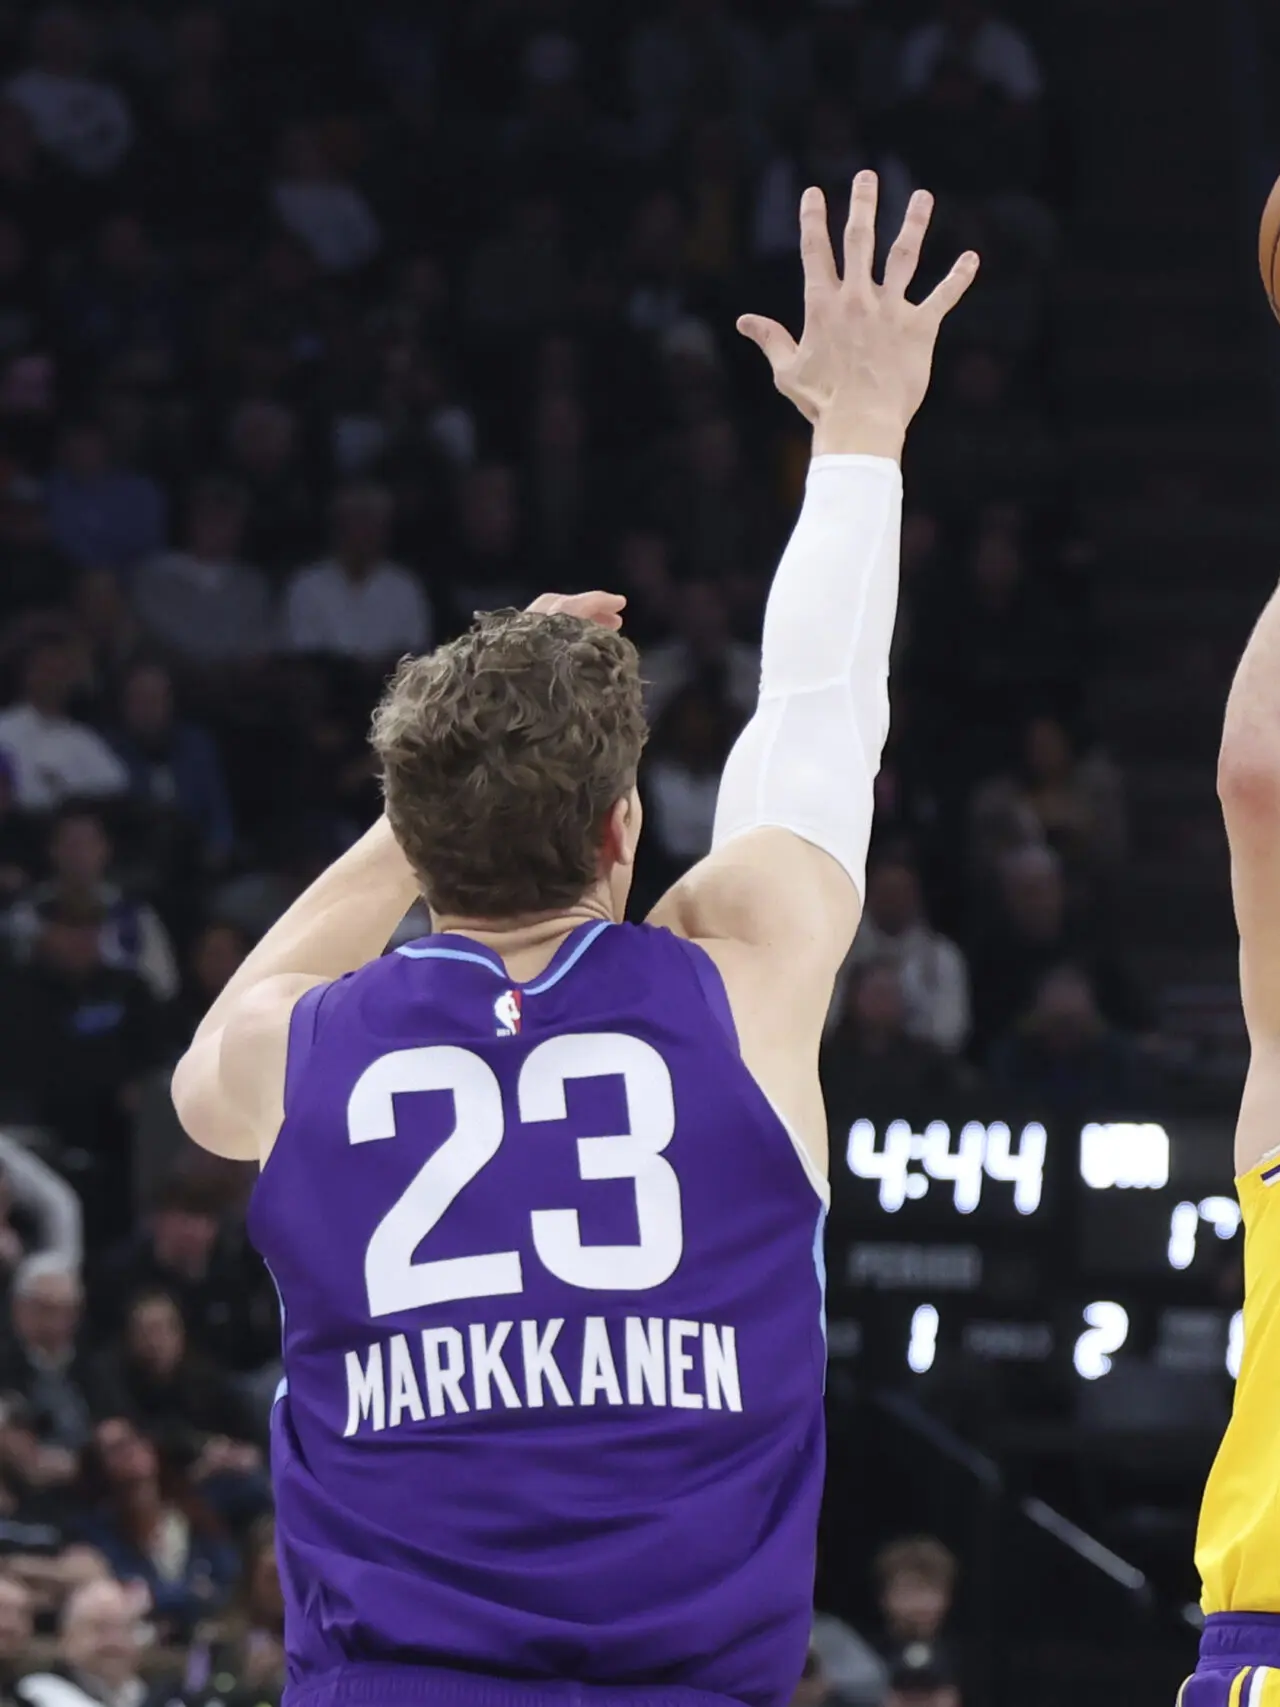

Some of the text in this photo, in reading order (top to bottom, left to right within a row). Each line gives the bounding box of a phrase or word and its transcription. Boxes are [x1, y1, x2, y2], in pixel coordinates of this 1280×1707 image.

[347, 1032, 683, 1318] 23
[847, 1118, 1047, 1215] 4:44
[343, 1316, 743, 1437] MARKKANEN
[1073, 1301, 1129, 1380] 2
